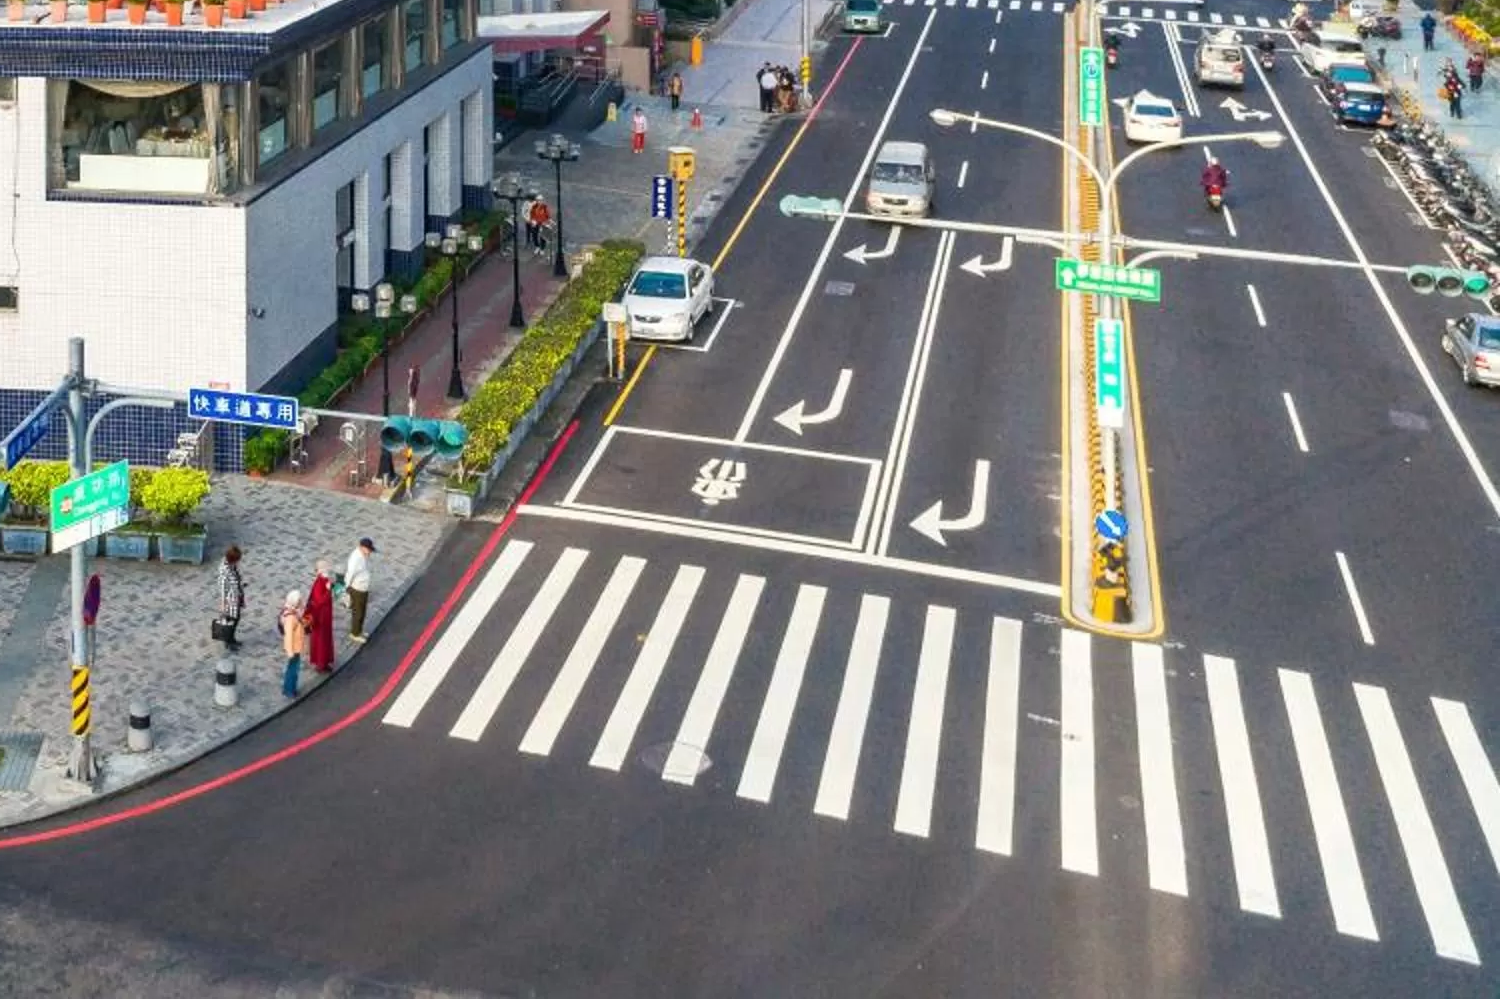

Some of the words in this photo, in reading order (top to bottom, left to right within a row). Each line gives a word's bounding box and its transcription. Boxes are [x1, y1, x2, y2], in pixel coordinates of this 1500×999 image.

[193, 393, 295, 422] 快車道專用
